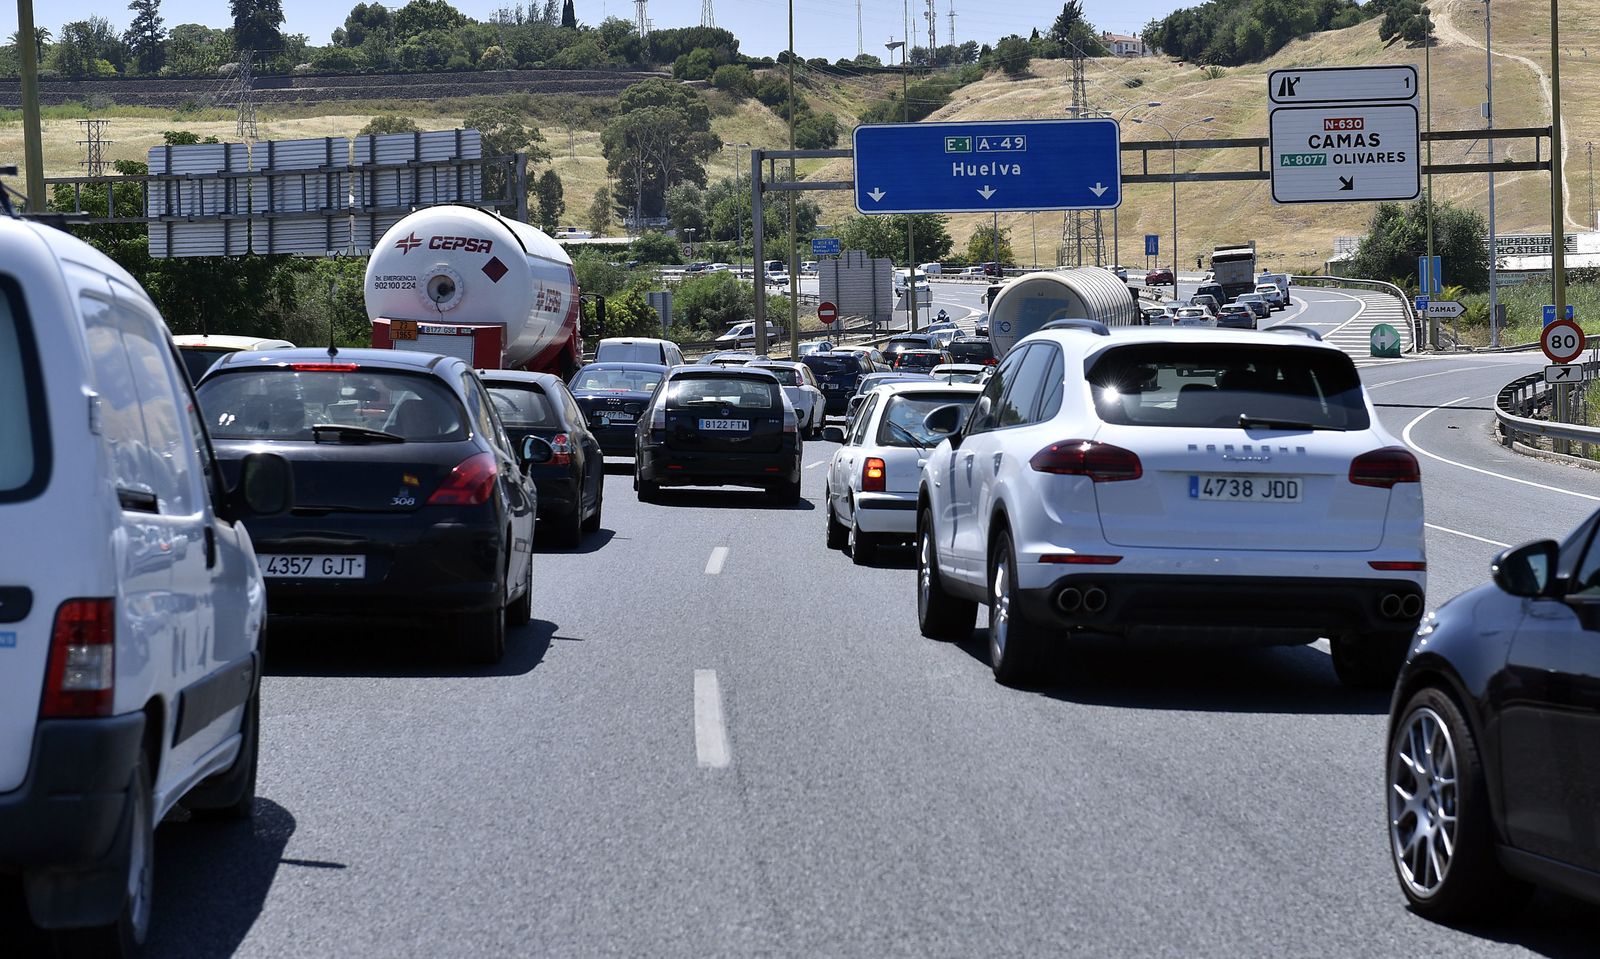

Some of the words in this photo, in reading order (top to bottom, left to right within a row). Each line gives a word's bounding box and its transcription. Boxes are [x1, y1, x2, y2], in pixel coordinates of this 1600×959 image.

[1403, 76, 1410, 89] 1
[1325, 119, 1363, 129] N-630
[947, 138, 970, 151] E-1
[979, 137, 1024, 150] A-49
[1308, 133, 1381, 149] CAMAS
[1282, 155, 1326, 165] A-8077
[1332, 152, 1406, 165] OLIVARES
[952, 161, 1021, 177] Huelva
[429, 235, 493, 254] CEPSA
[1497, 246, 1570, 255] HOSTELEA
[426, 326, 441, 334] 8177
[1551, 334, 1576, 349] 80
[705, 421, 728, 429] 8122
[730, 422, 748, 430] FTM
[1203, 478, 1253, 497] 4738
[1262, 480, 1298, 499] JDD
[390, 497, 415, 506] 308
[267, 557, 313, 575] 4357
[322, 558, 357, 575] GJT
